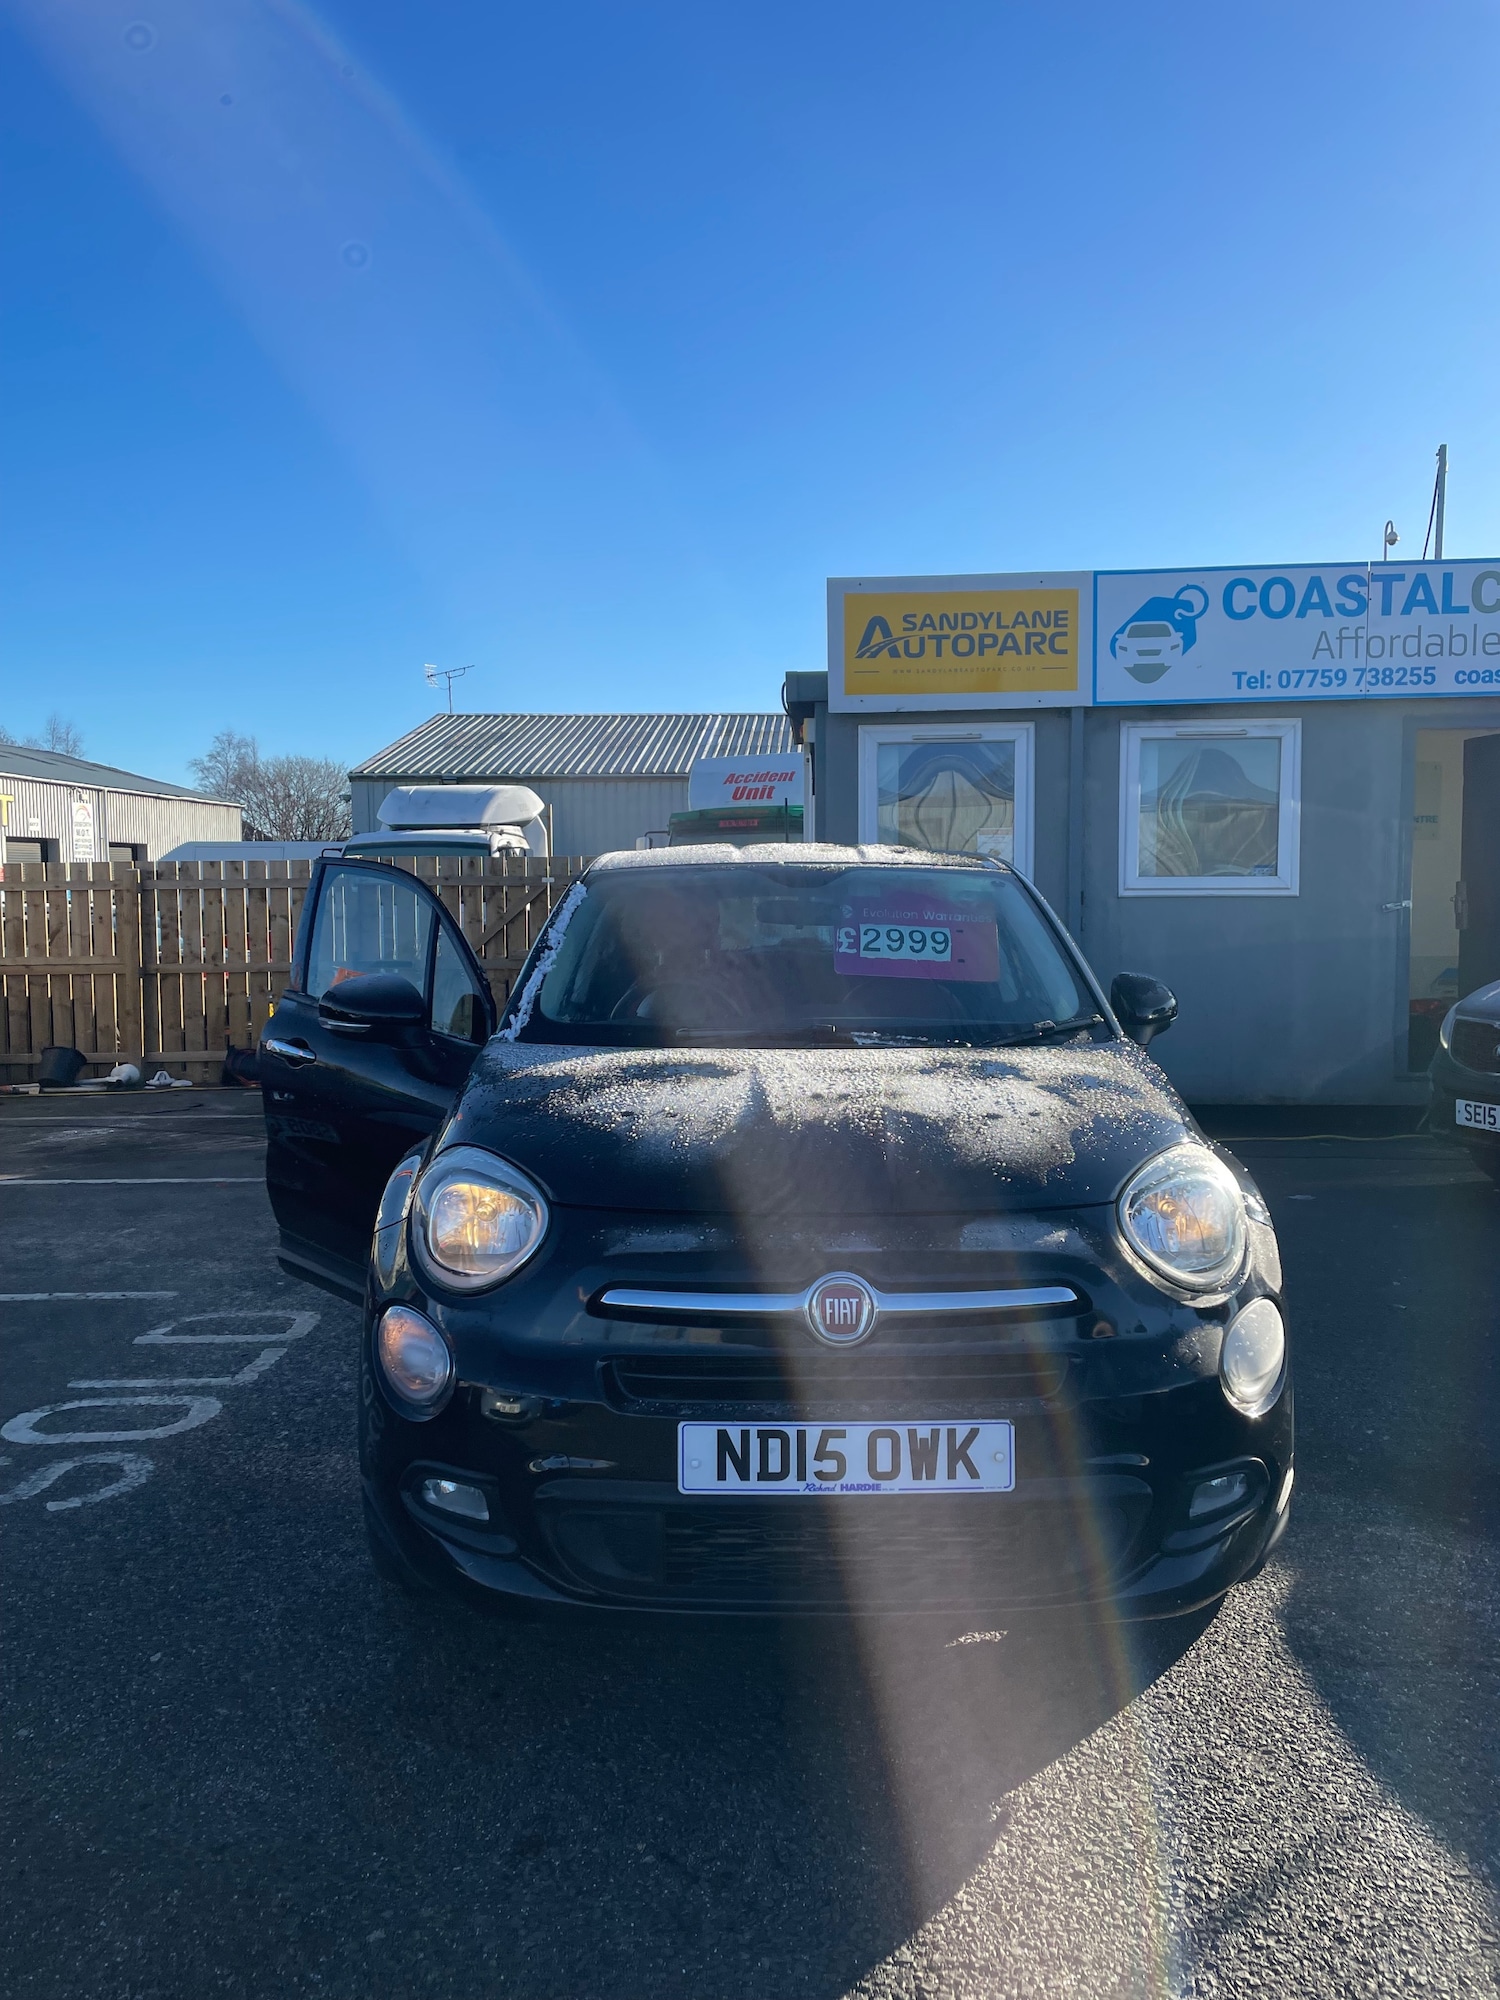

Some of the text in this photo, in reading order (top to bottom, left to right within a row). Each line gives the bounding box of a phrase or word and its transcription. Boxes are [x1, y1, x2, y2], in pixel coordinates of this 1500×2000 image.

[902, 610, 1069, 632] SANDYLANE
[855, 615, 1069, 659] AUTOPARC
[1312, 623, 1500, 661] Affordable
[1232, 666, 1437, 690] Tel: 07759 738255
[723, 771, 796, 785] Accident
[731, 785, 775, 801] Unit
[863, 907, 918, 920] Evolution
[825, 1298, 860, 1325] FIAT
[716, 1427, 981, 1482] ND15 OWK
[803, 1482, 837, 1492] Richard
[840, 1483, 882, 1491] HARDIE
